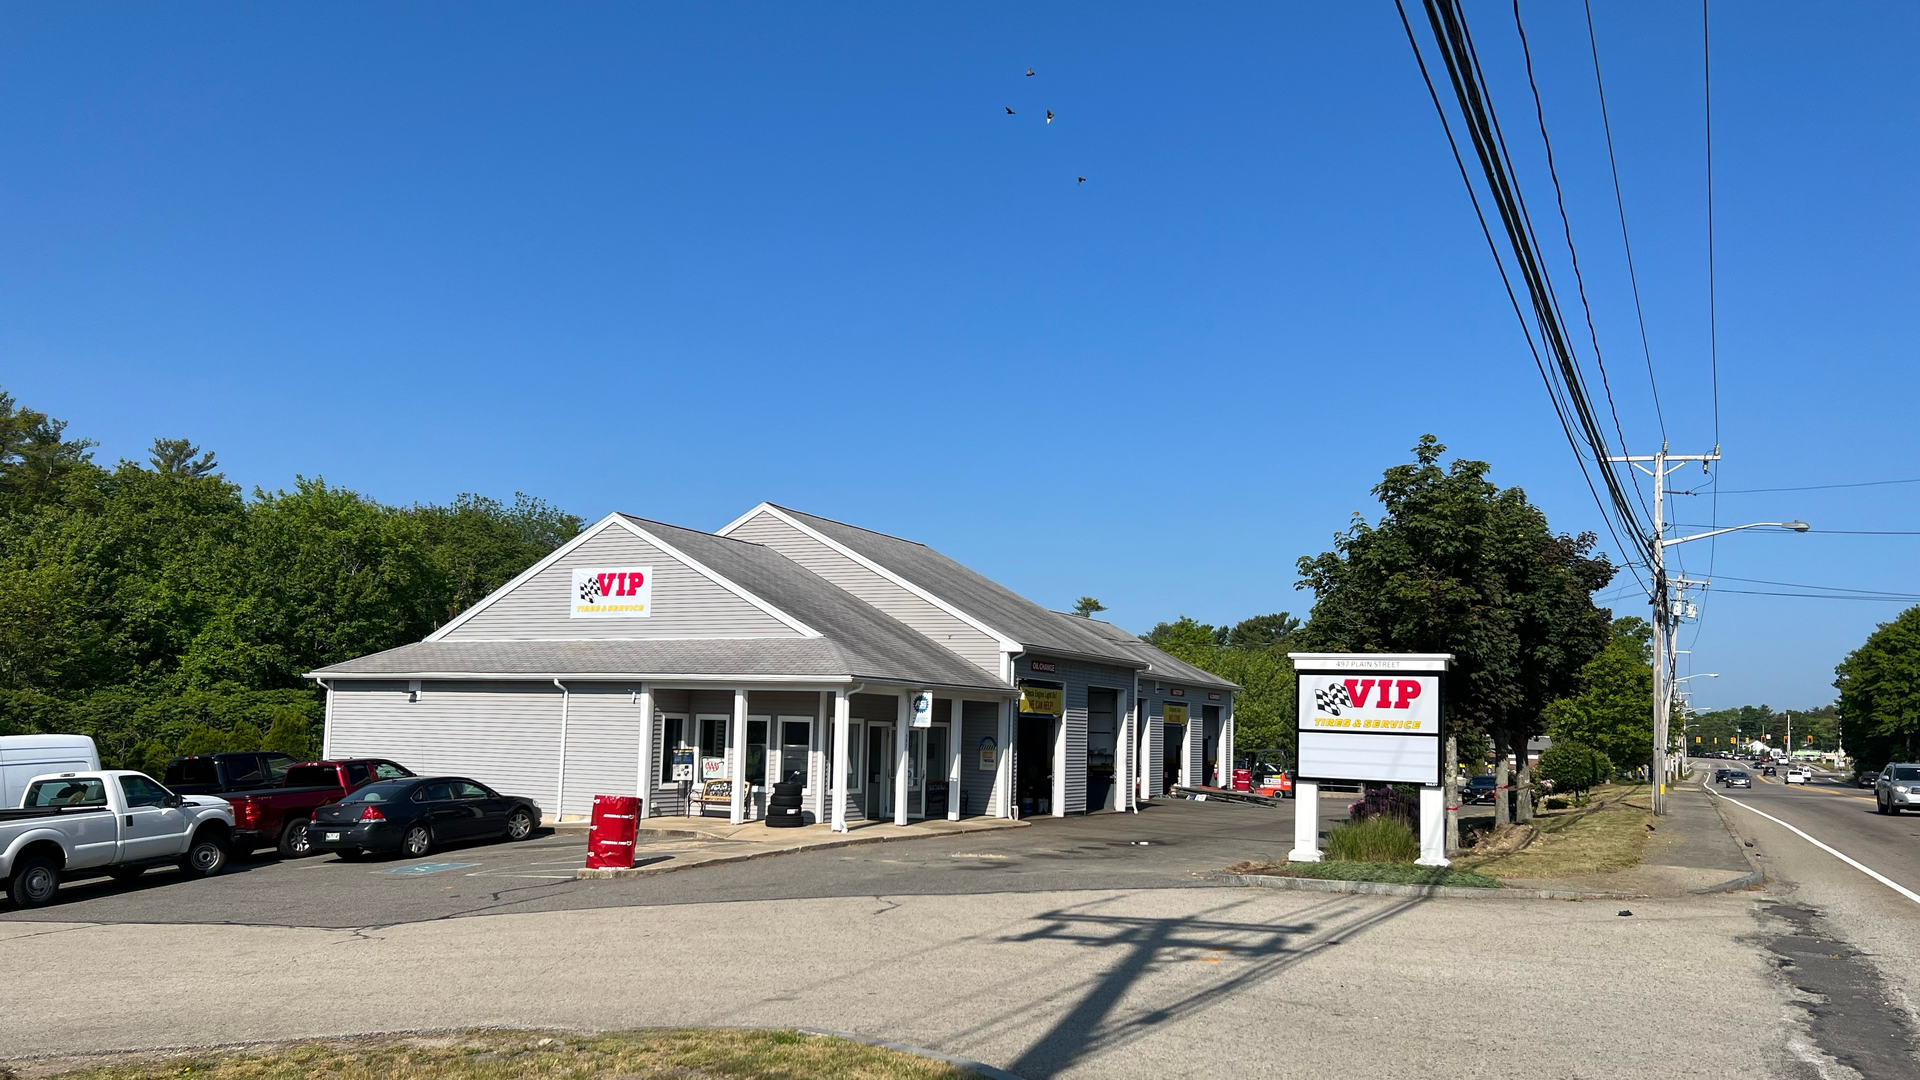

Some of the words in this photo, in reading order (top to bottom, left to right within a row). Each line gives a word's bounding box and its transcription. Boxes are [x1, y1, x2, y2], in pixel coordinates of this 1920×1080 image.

[597, 572, 644, 596] VIP
[577, 604, 601, 612] TIRES
[607, 604, 644, 612] SERVICE
[1343, 679, 1421, 709] VIP
[1315, 718, 1351, 727] TIRES
[1352, 719, 1361, 728] &
[1363, 720, 1421, 729] SERVICE
